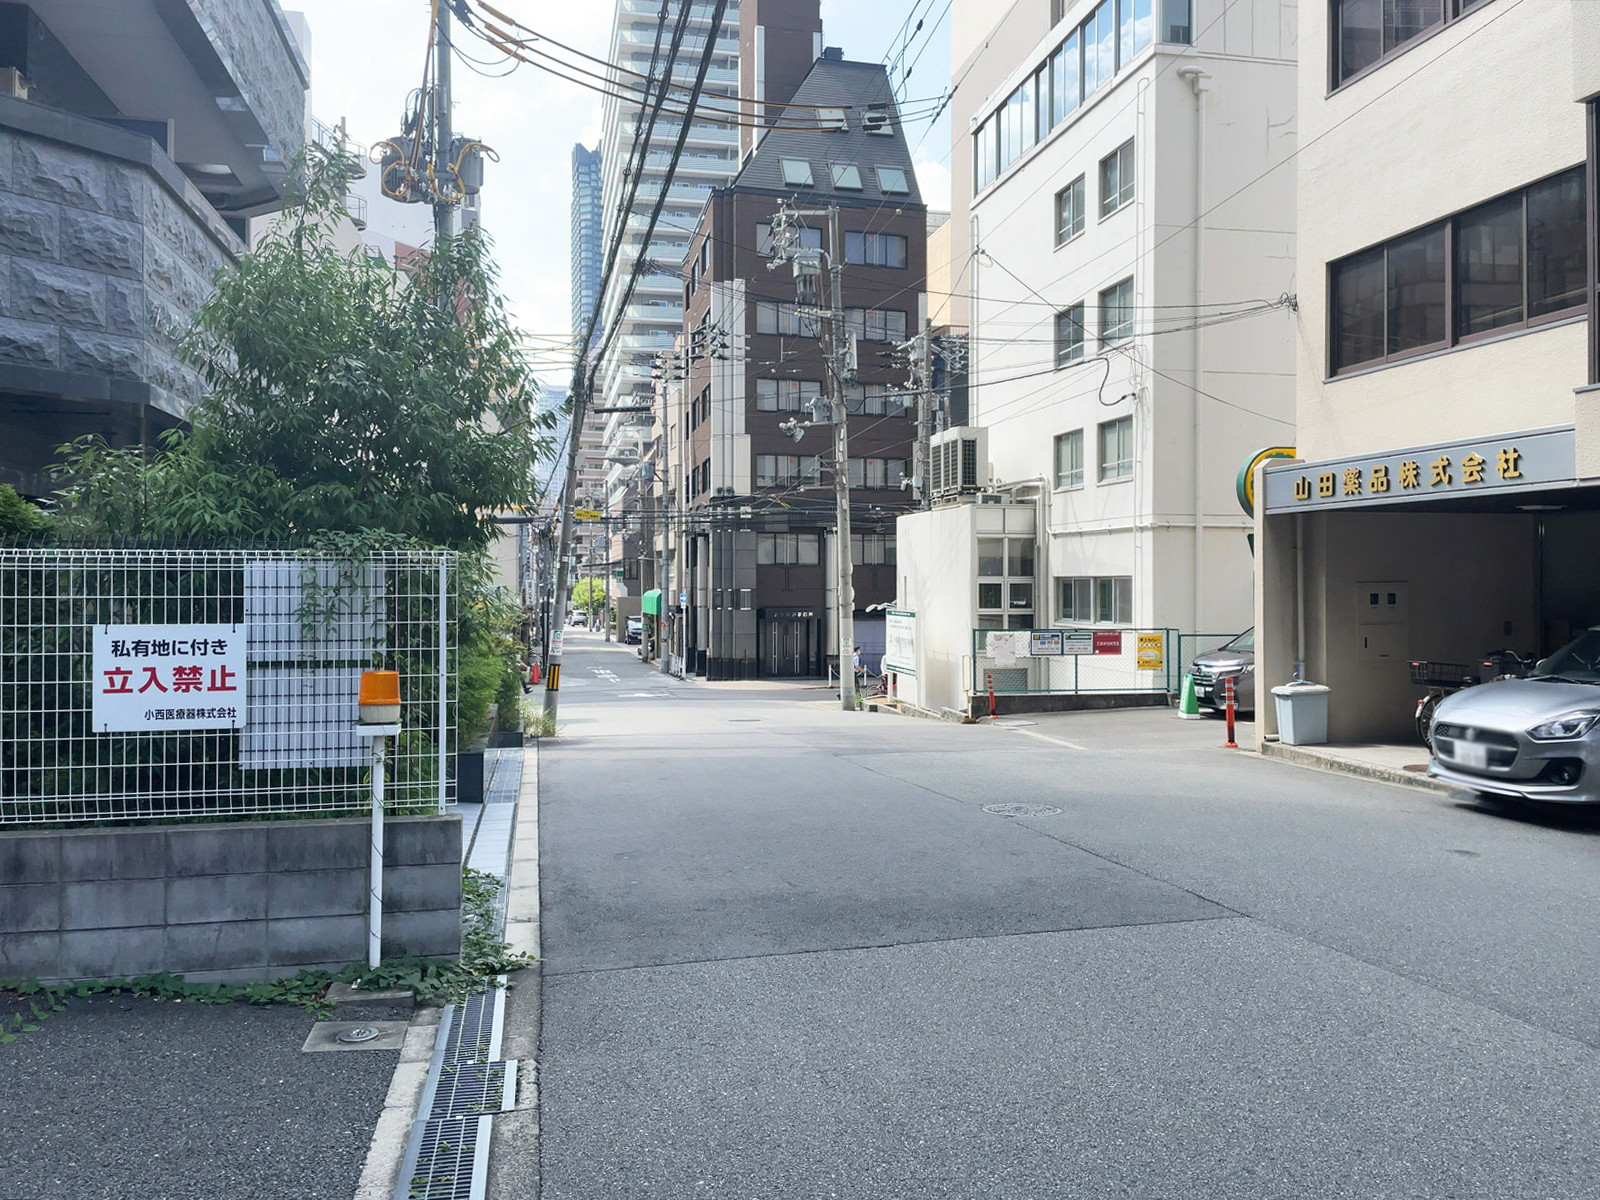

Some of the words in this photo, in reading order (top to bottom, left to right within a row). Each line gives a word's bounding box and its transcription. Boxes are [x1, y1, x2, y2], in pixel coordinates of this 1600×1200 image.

[1293, 447, 1523, 500] 山田薬品株式会社
[111, 639, 228, 657] 私有地に付き
[102, 665, 237, 694] 立入禁止
[144, 707, 238, 721] 小西医療器株式会社
